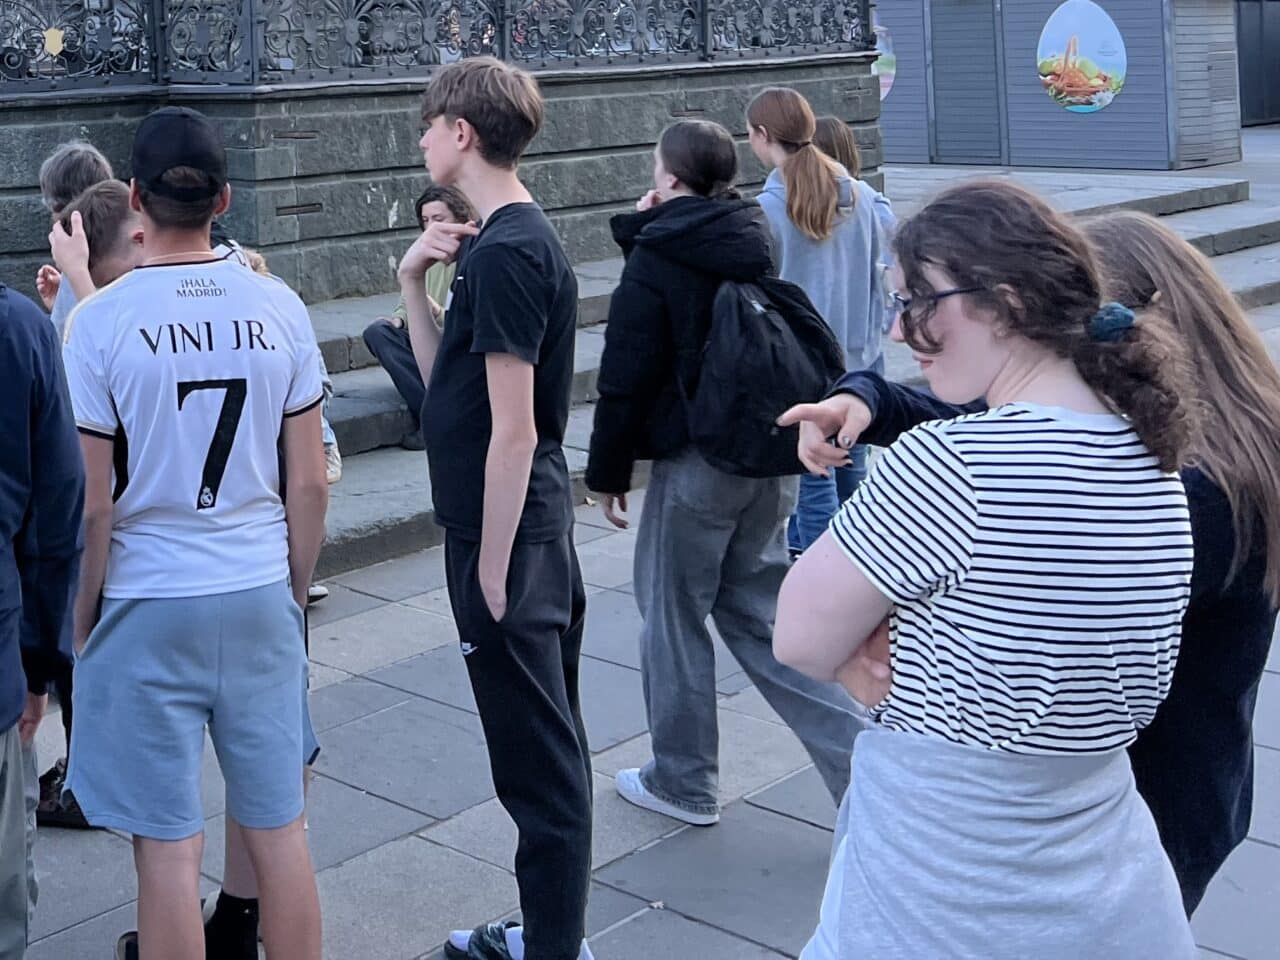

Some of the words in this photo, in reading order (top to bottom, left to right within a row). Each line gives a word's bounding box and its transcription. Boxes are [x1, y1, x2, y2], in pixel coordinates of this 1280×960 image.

[176, 288, 228, 297] MADRID!
[139, 321, 214, 355] VINI
[231, 320, 275, 351] JR.
[177, 378, 247, 510] 7
